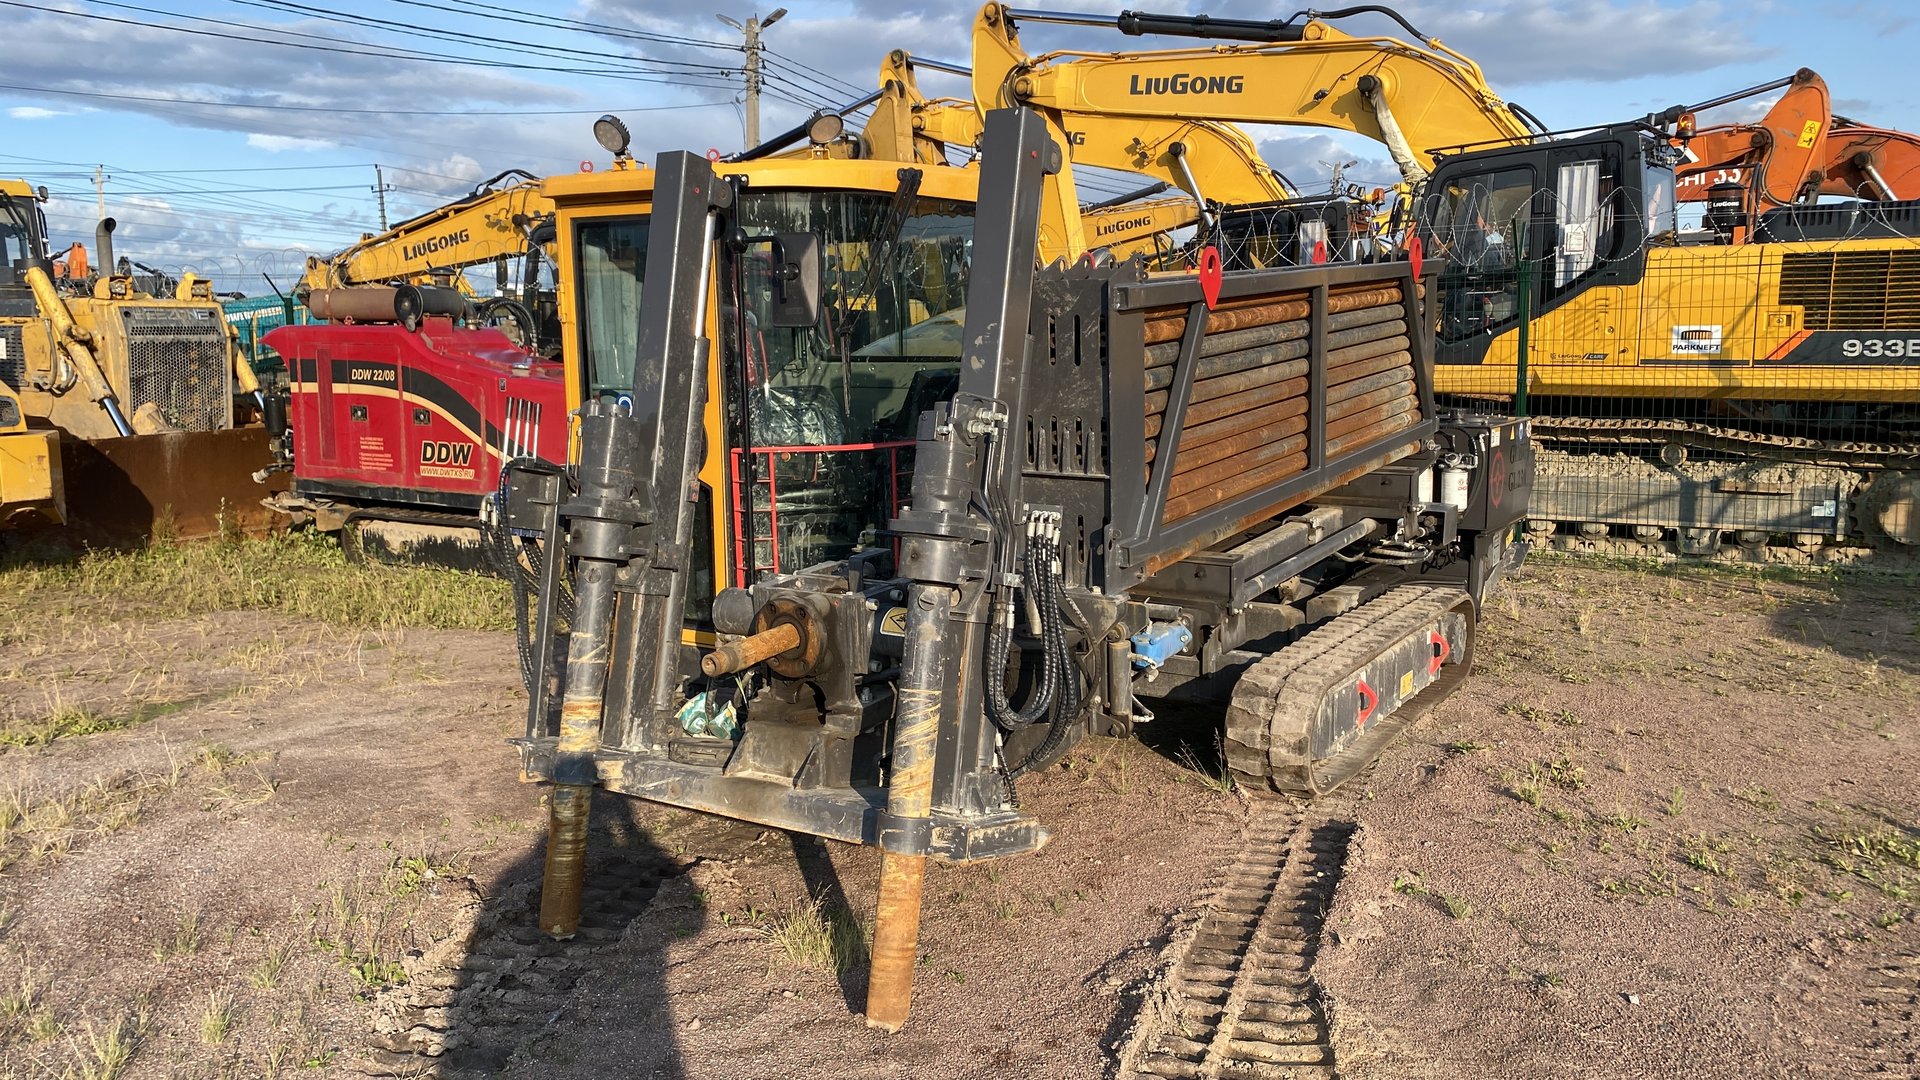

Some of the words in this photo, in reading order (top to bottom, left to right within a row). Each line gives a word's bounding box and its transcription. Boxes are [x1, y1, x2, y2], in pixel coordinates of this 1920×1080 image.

[1129, 73, 1244, 96] LIUGONG
[1096, 216, 1151, 236] LIUGONG
[402, 228, 470, 262] LIUGONG
[1842, 338, 1920, 358] 933E
[351, 369, 372, 380] DDW
[373, 369, 395, 381] 22/08
[421, 441, 473, 466] DDW
